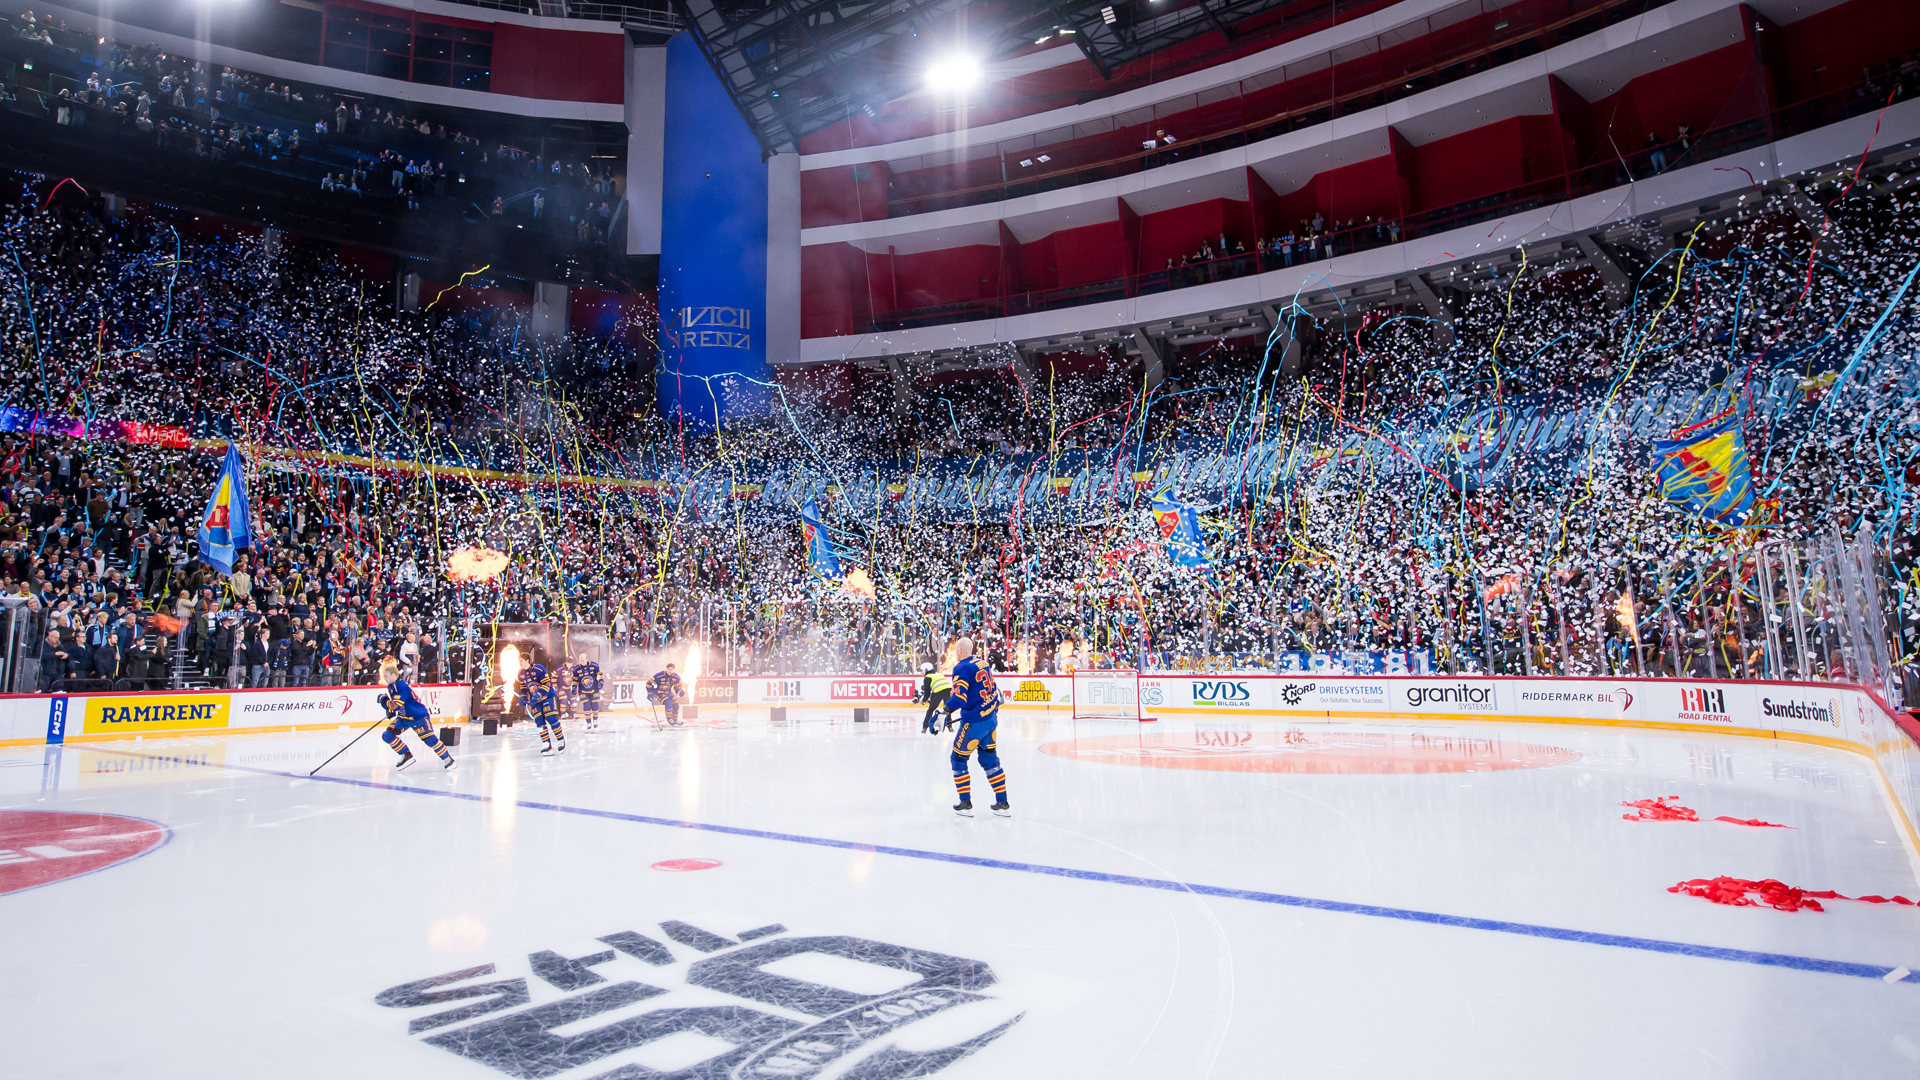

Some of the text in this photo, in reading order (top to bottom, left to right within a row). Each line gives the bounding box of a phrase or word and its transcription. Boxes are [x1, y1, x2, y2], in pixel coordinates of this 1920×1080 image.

[668, 306, 750, 330] AVICII
[668, 331, 750, 350] ARENA
[833, 682, 913, 698] METROLIT
[1020, 681, 1044, 691] EURO
[1088, 682, 1164, 705] Flinks
[1192, 681, 1250, 700] RYDS
[1290, 683, 1384, 698] NORD DRIVESYSTEMS
[1013, 690, 1052, 701] JACKPOT
[1407, 684, 1491, 707] granitor
[1522, 692, 1614, 703] RIDDERMARK BIL
[101, 704, 216, 723] RAMIRENT
[244, 701, 334, 713] RIDDERMARK BIL
[1458, 702, 1493, 710] SYSTEMS
[1762, 698, 1829, 722] Sundström
[52, 699, 63, 736] CCM
[1678, 713, 1733, 723] ROAD RENTAL
